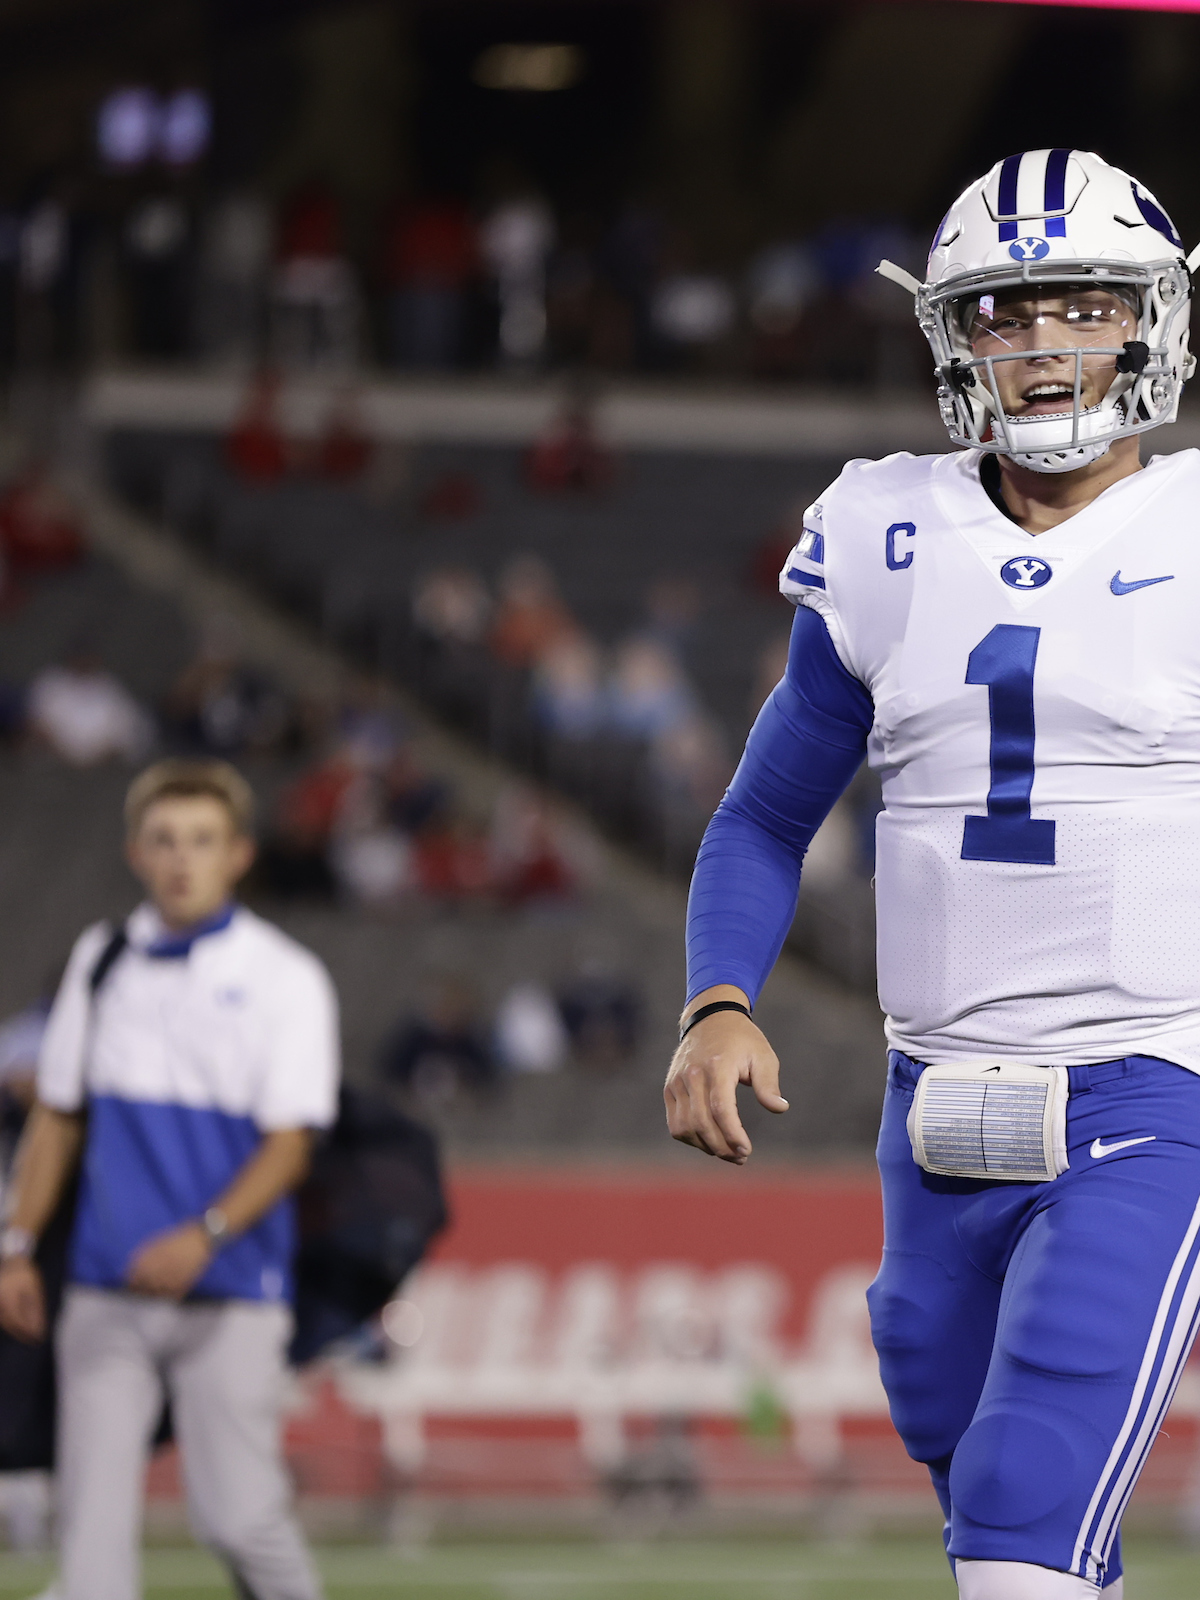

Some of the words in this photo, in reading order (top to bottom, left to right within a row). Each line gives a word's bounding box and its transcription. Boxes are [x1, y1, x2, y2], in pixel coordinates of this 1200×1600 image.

[1013, 237, 1044, 259] Y
[886, 521, 917, 571] C
[1008, 558, 1047, 587] Y
[960, 623, 1056, 866] 1
